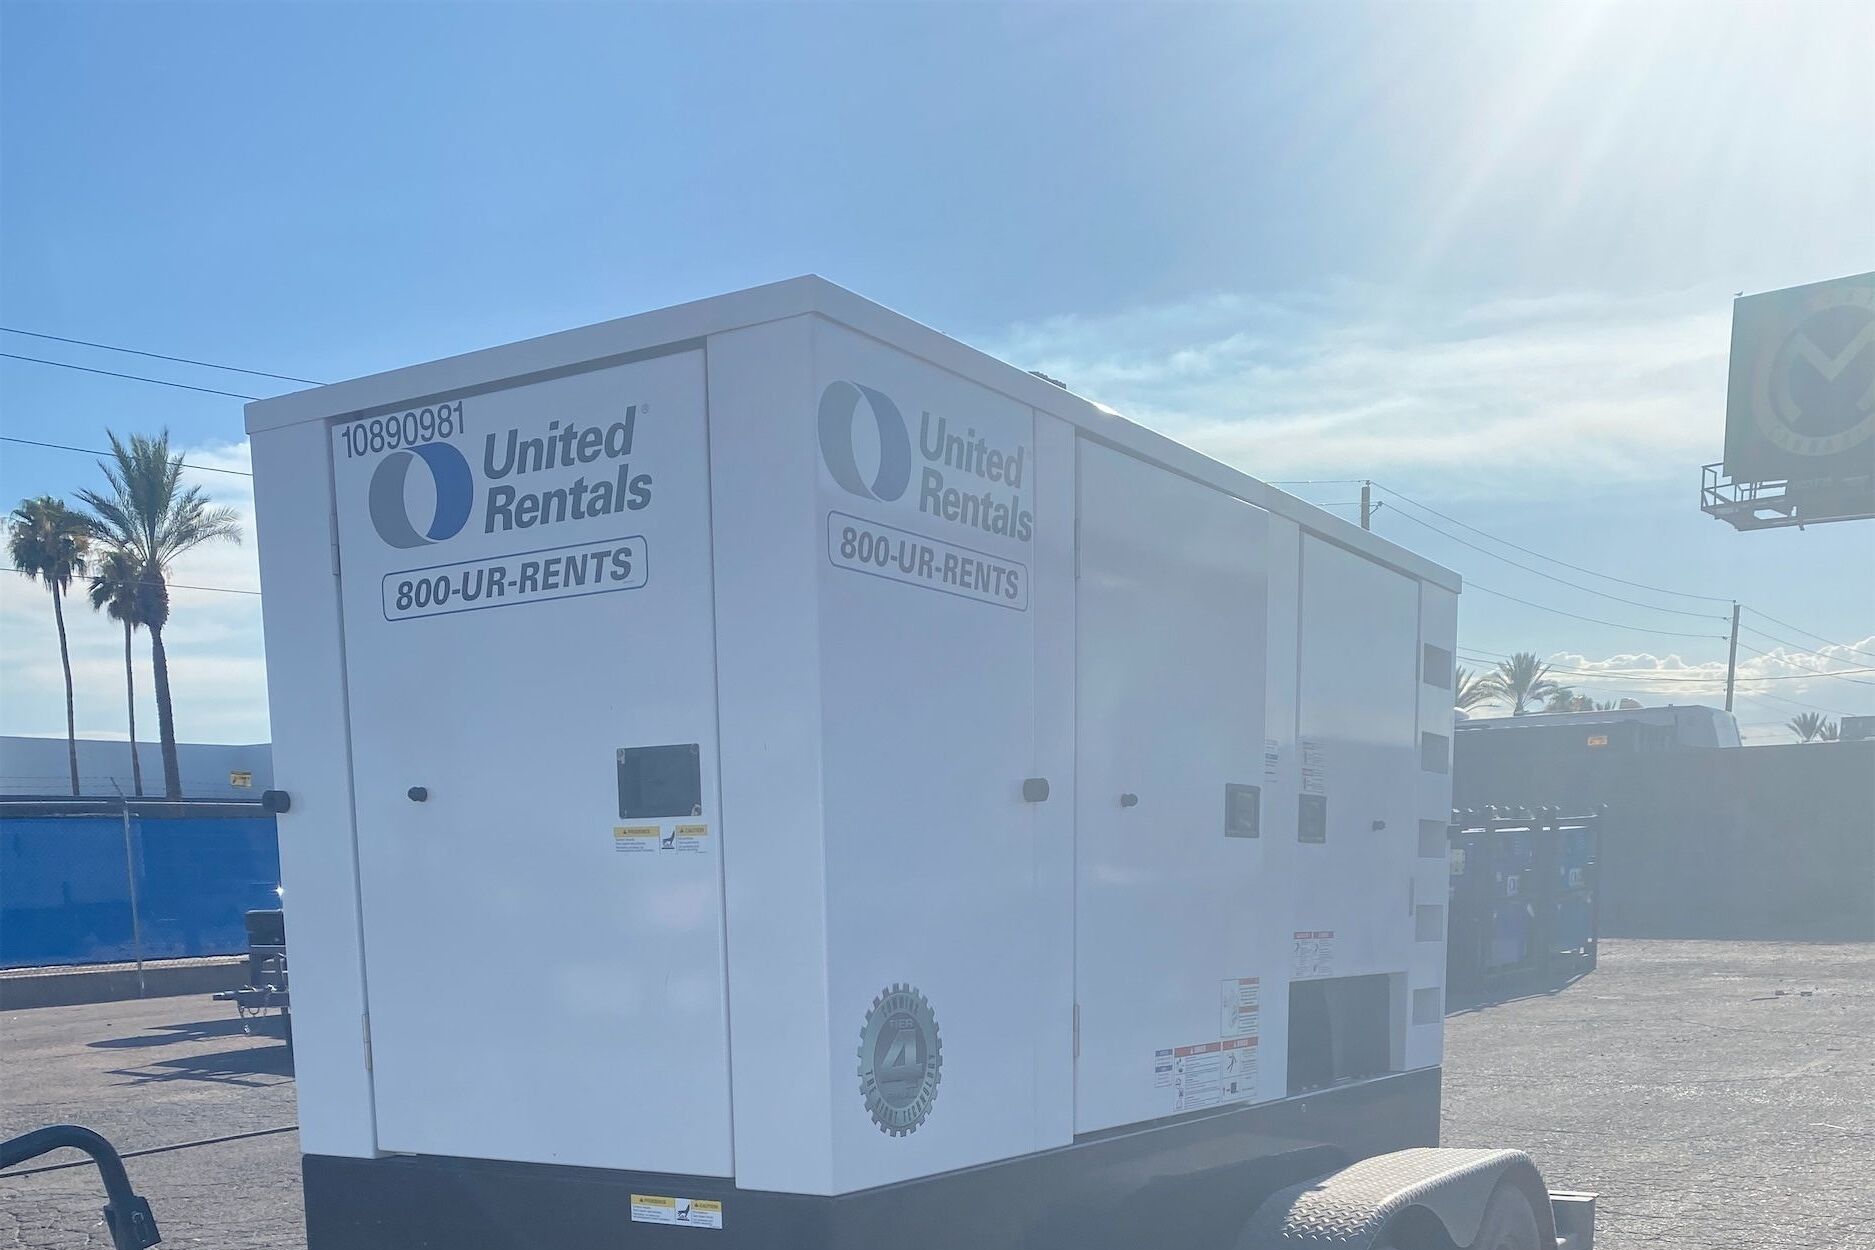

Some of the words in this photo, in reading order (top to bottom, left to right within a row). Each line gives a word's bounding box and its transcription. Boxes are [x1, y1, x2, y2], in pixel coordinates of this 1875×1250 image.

[341, 400, 465, 459] 10890981
[483, 405, 637, 480] United
[919, 410, 1025, 489] United
[484, 463, 653, 534] Rentals
[918, 465, 1034, 543] Rentals
[395, 546, 633, 611] 800-UR-RENTS
[839, 526, 1020, 600] 800-UR-RENTS
[880, 1029, 924, 1082] 4
